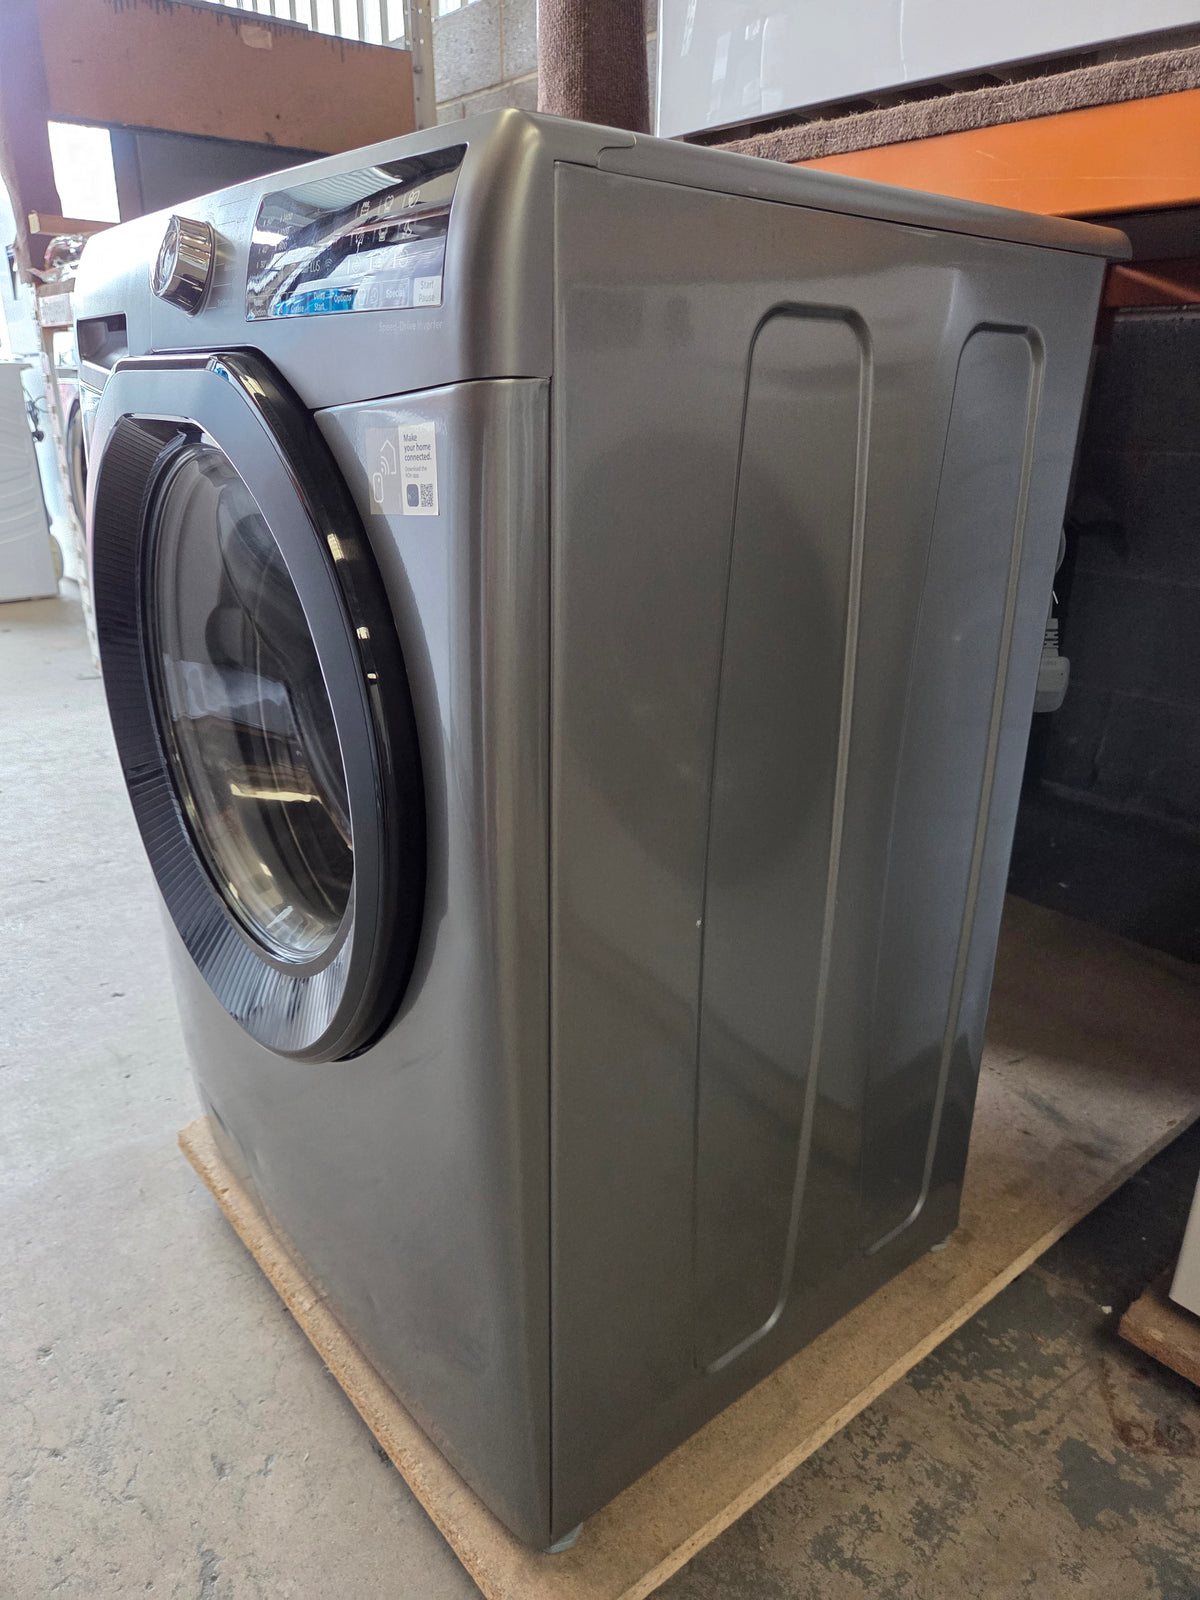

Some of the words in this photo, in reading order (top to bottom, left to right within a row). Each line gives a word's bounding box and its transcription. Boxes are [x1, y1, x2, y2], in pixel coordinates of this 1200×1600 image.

[420, 280, 434, 289] Start
[333, 293, 352, 304] Options
[403, 433, 418, 441] Make
[404, 445, 415, 453] your
[416, 443, 431, 451] home
[404, 453, 432, 461] connected.
